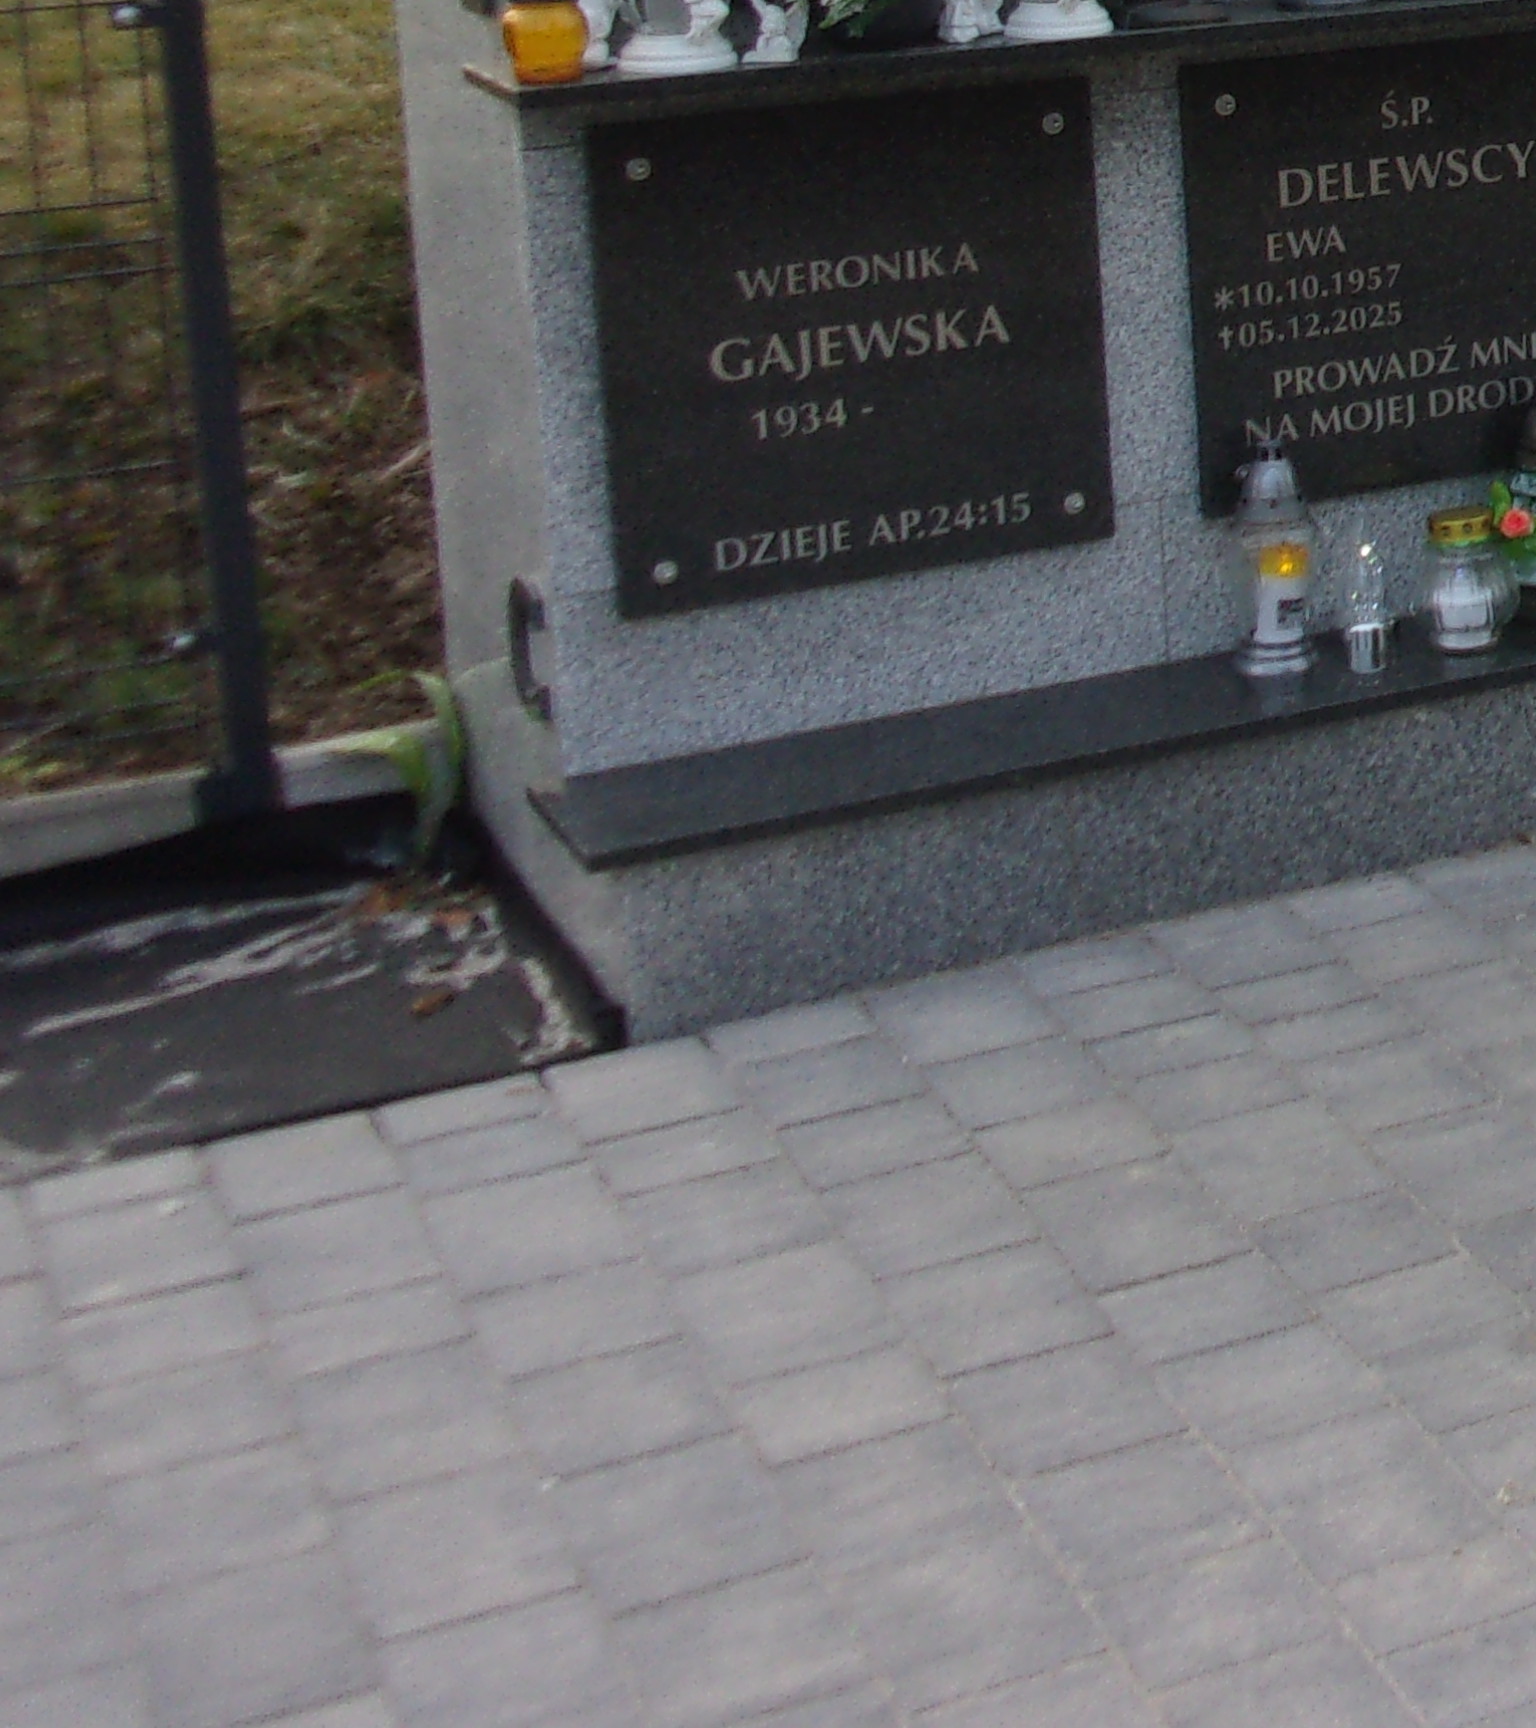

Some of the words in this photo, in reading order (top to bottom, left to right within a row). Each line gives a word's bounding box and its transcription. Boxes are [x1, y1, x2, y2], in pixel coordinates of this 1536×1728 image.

[1380, 90, 1433, 130] Ś.P.
[1278, 140, 1536, 208] DELEWSCY
[1266, 225, 1347, 262] EWA
[734, 242, 979, 301] WERONIKA
[710, 304, 1011, 382] GAJEWSKA
[1273, 335, 1460, 399] PROWADŹ
[750, 398, 848, 441] 1934
[1244, 413, 1300, 447] NA
[1309, 395, 1416, 438] MOJEJ
[714, 520, 852, 571] DZIEJE
